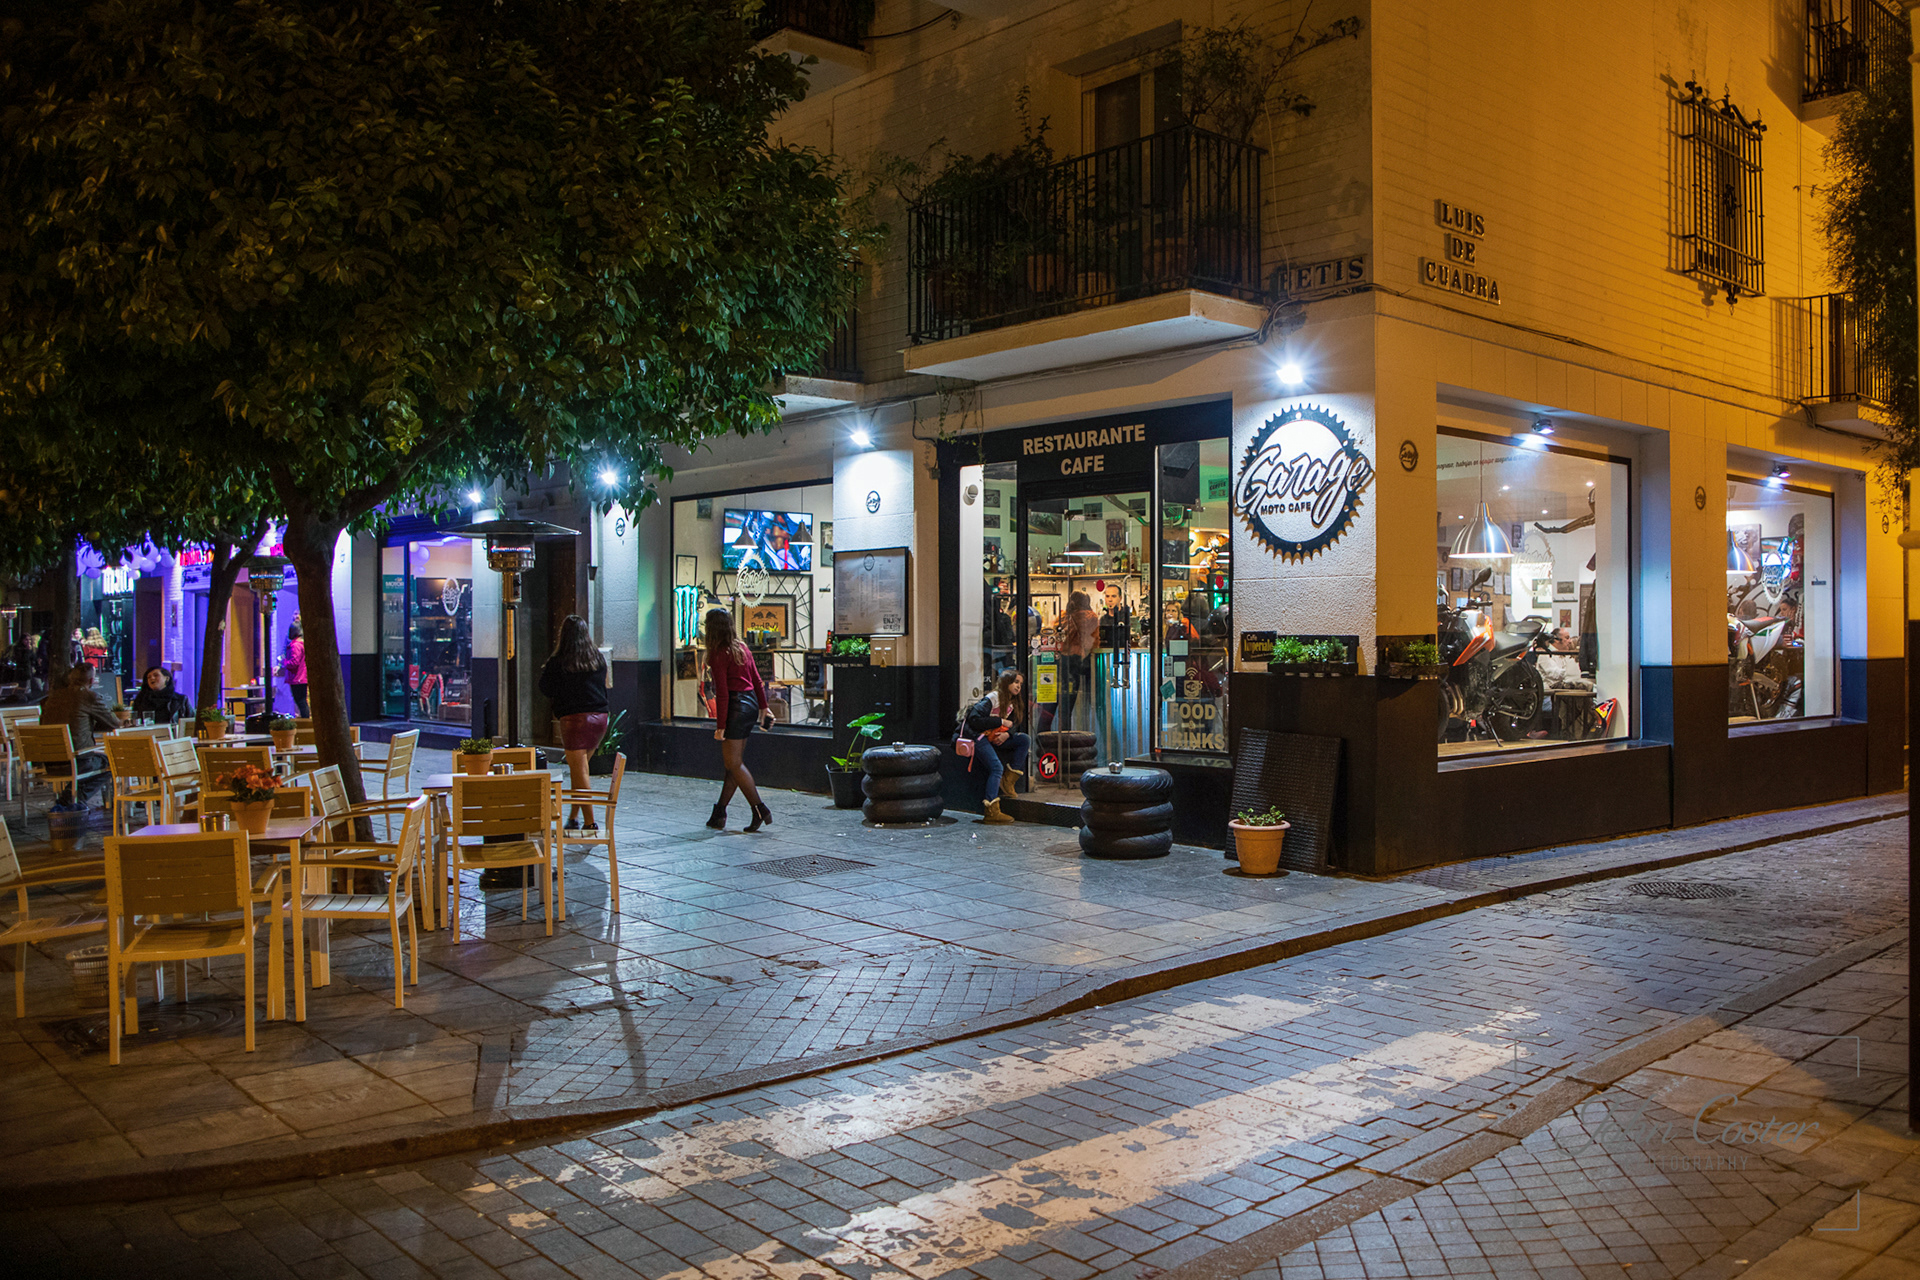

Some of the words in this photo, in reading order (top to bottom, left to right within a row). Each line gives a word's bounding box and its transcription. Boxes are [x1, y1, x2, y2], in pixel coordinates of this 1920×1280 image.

[1442, 203, 1484, 236] LUIS
[1453, 237, 1475, 264] DE
[1427, 262, 1499, 300] CUADRA
[1023, 424, 1146, 456] RESTAURANTE
[1061, 454, 1104, 476] CAFE
[1236, 443, 1374, 526] Garage
[1261, 503, 1285, 516] MOTO
[1288, 501, 1311, 514] CAFE
[1169, 703, 1216, 720] FOOD
[1161, 730, 1226, 750] DRINKS
